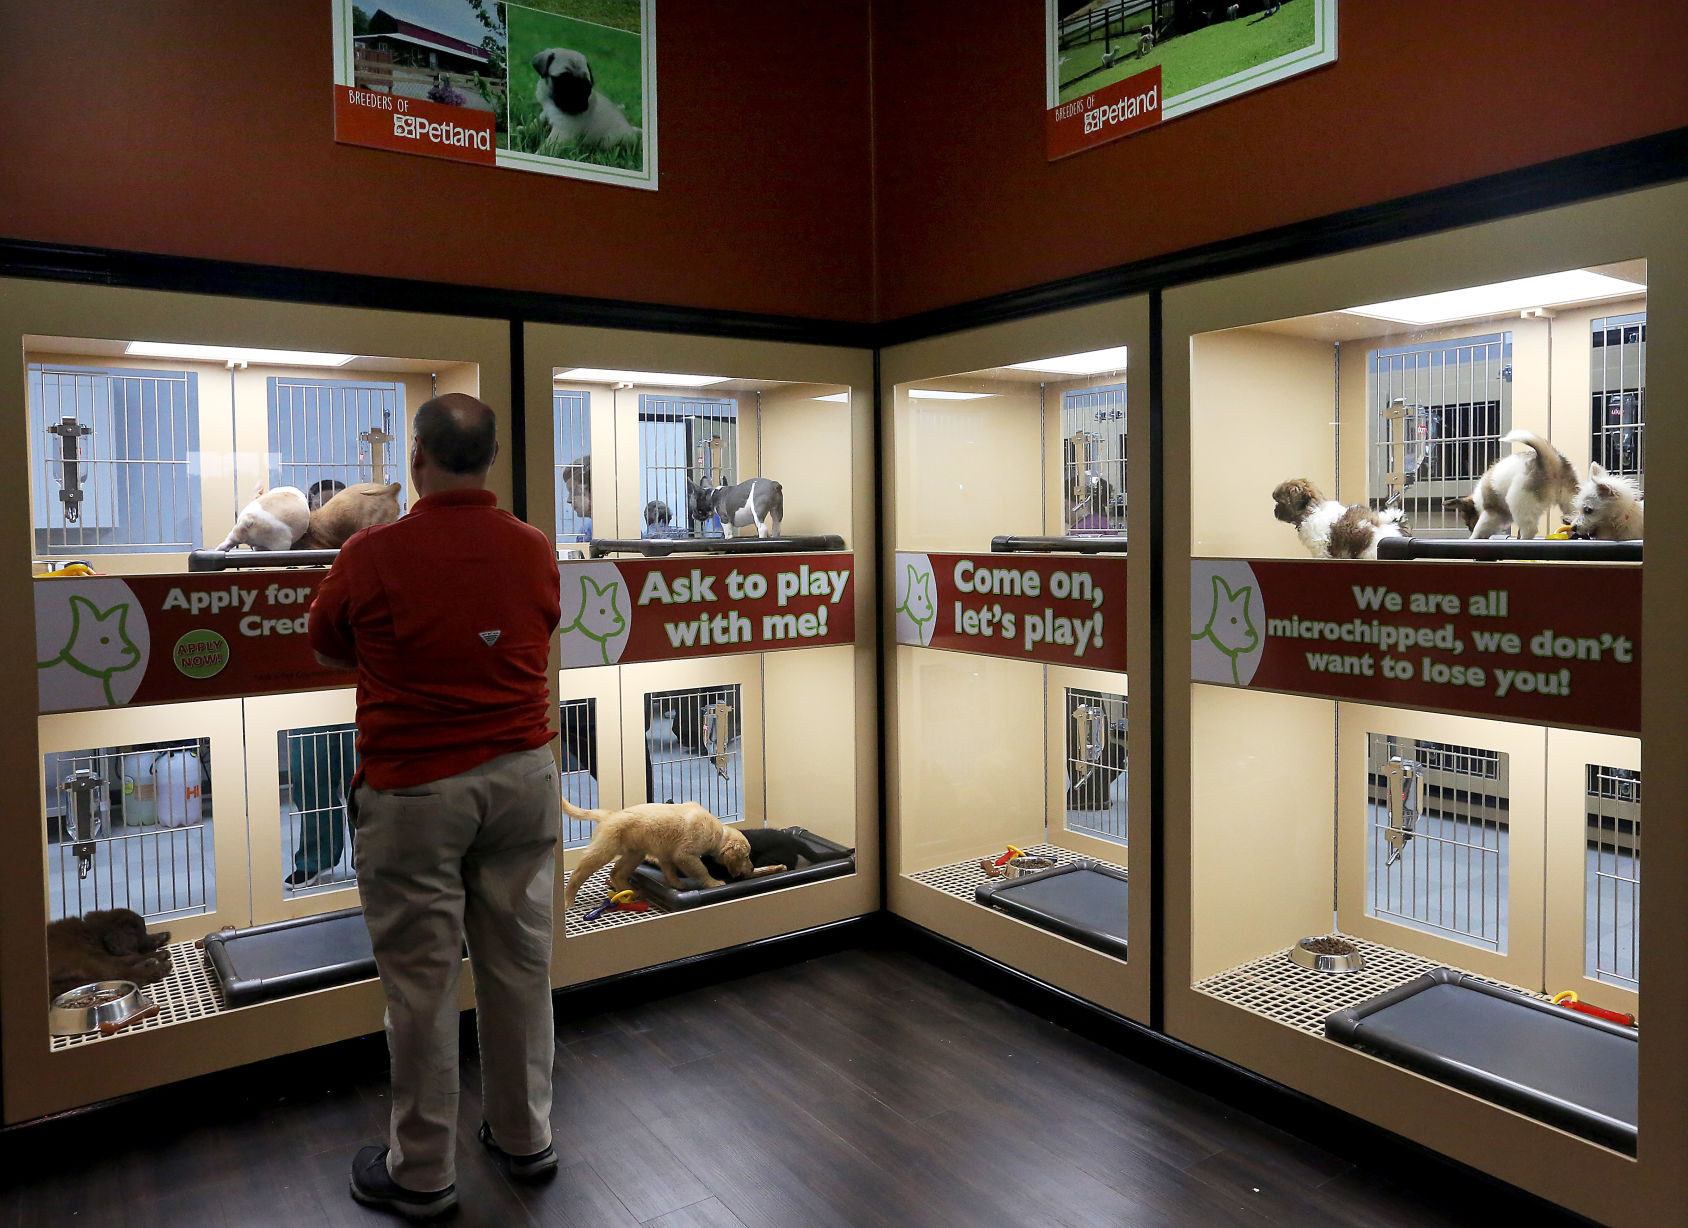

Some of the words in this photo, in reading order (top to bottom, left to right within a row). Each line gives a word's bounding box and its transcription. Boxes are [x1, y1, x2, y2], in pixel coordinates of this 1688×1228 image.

[349, 89, 393, 111] BREEDERS
[397, 98, 409, 113] OF
[1055, 99, 1084, 122] BREEDERS
[1086, 94, 1095, 110] OF
[1100, 85, 1158, 129] Petland
[415, 117, 490, 150] Petland
[162, 585, 259, 615] Apply
[264, 584, 312, 605] for
[637, 569, 718, 606] Ask
[725, 568, 768, 600] to
[777, 564, 850, 607] play
[954, 559, 1041, 597] Come
[1050, 570, 1104, 608] on,
[1352, 585, 1402, 612] We
[1409, 592, 1461, 615] are
[1468, 590, 1509, 618] all
[239, 612, 310, 637] Cred
[664, 610, 752, 648] with
[762, 604, 828, 640] me!
[954, 600, 1016, 640] let's
[1024, 608, 1104, 657] play!
[1267, 615, 1465, 655] microchipped,
[1471, 629, 1522, 655] we
[1529, 630, 1633, 664] don't
[178, 640, 222, 656] APPLY
[1305, 652, 1375, 677] want
[1381, 654, 1414, 680] to
[1422, 656, 1486, 688] lose
[1494, 667, 1572, 698] you!
